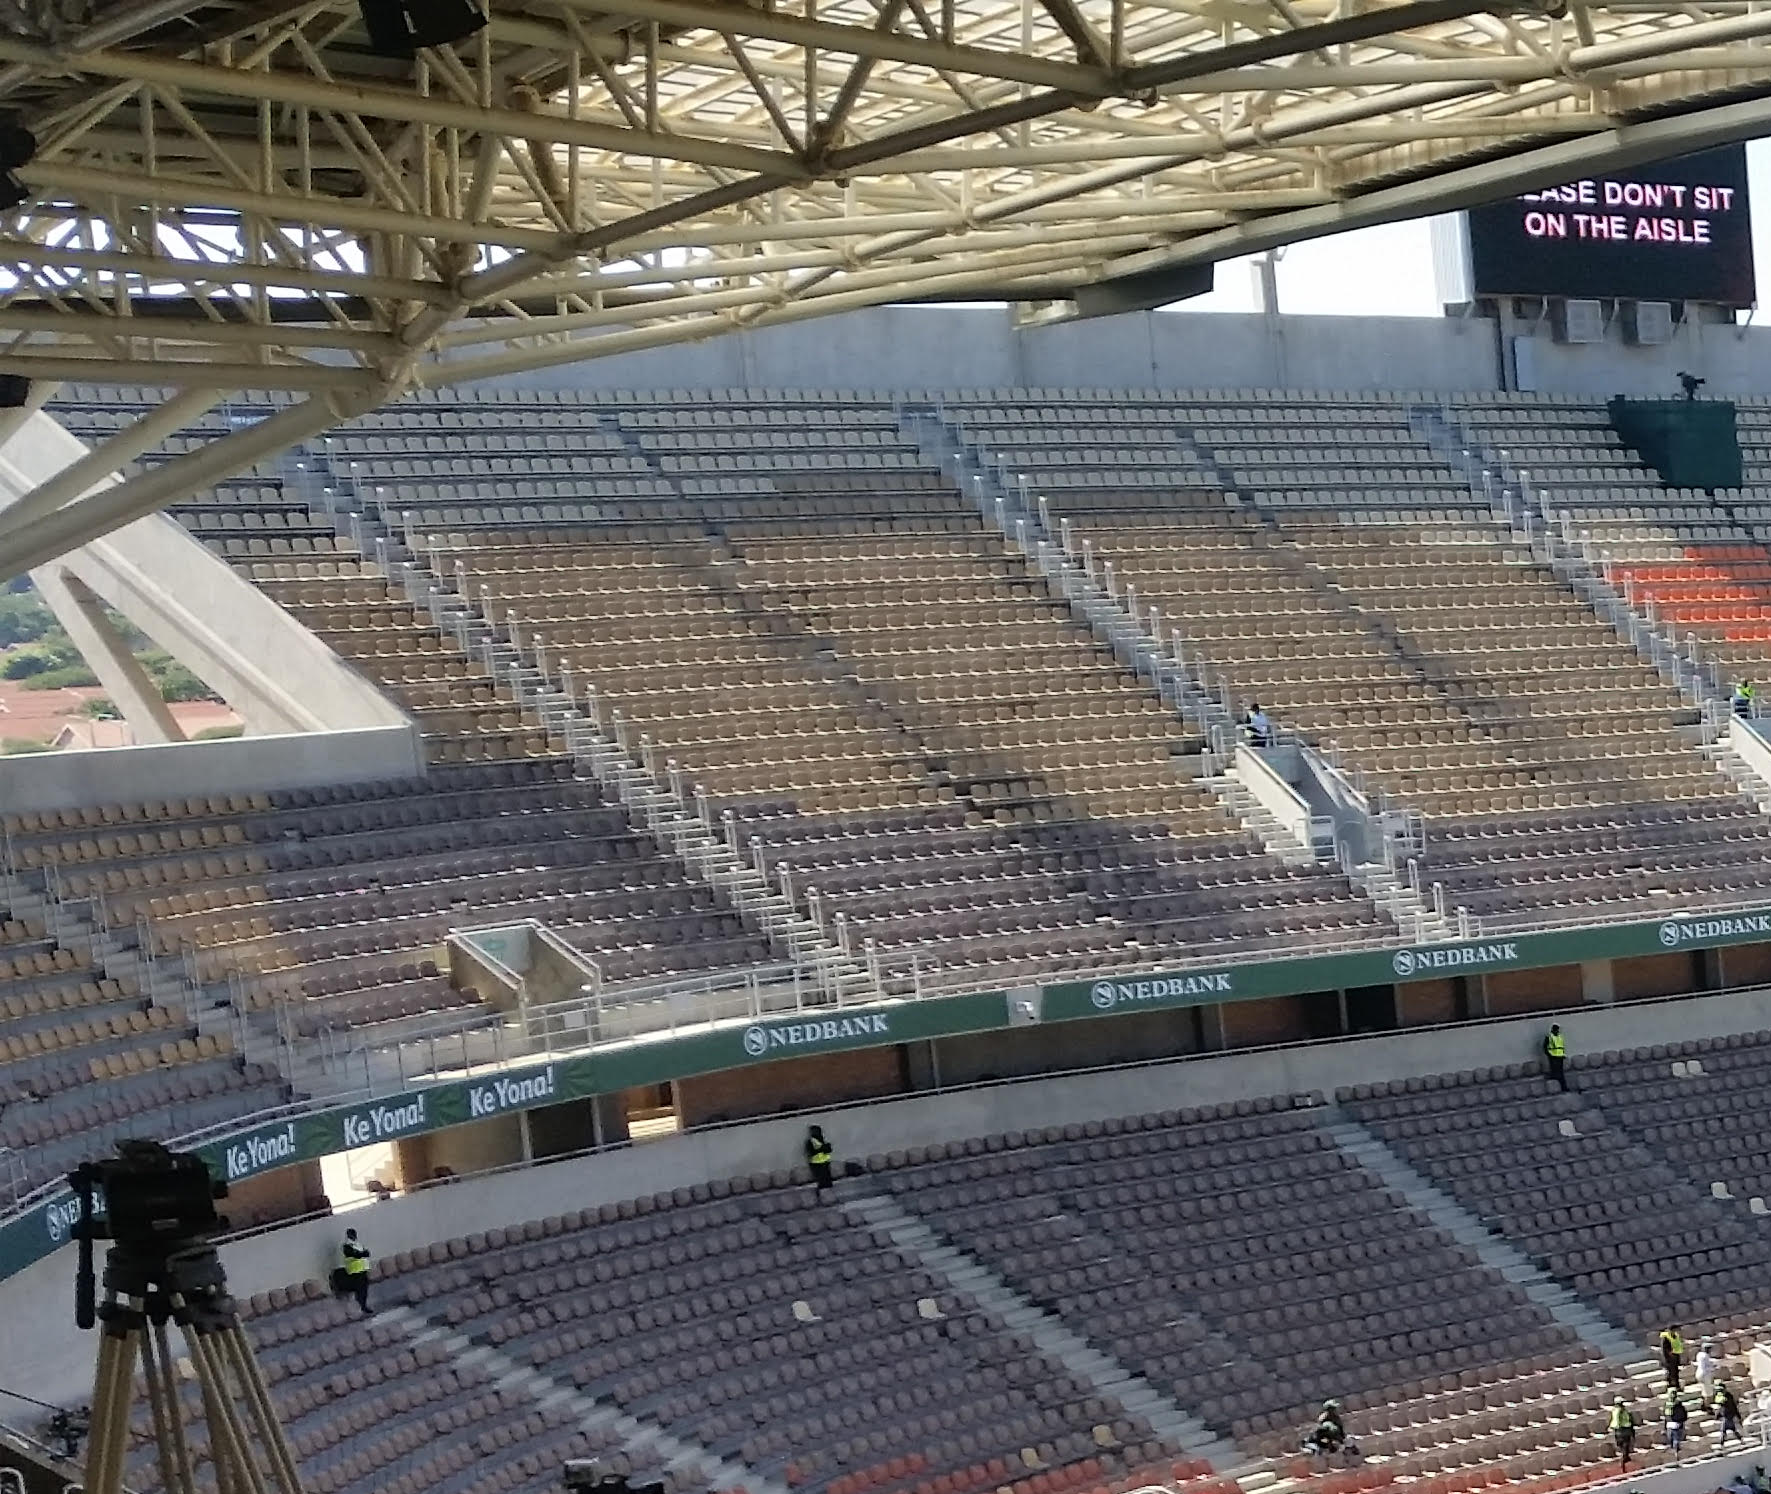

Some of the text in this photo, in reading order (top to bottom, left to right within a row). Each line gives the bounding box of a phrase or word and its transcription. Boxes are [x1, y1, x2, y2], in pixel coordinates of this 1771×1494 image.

[1604, 181, 1687, 210] DON'T
[1693, 186, 1735, 211] SIT
[1524, 212, 1712, 244] ON THE AISLE
[1681, 913, 1771, 942] NEDBANK
[1416, 942, 1518, 970] NEDBANK
[1118, 972, 1232, 1003] NEDBANK
[767, 1015, 890, 1050] NEDBANK
[471, 1065, 555, 1117] Ke Yona!
[344, 1094, 425, 1146] Ke Yona!
[227, 1122, 296, 1179] Ke Yona!
